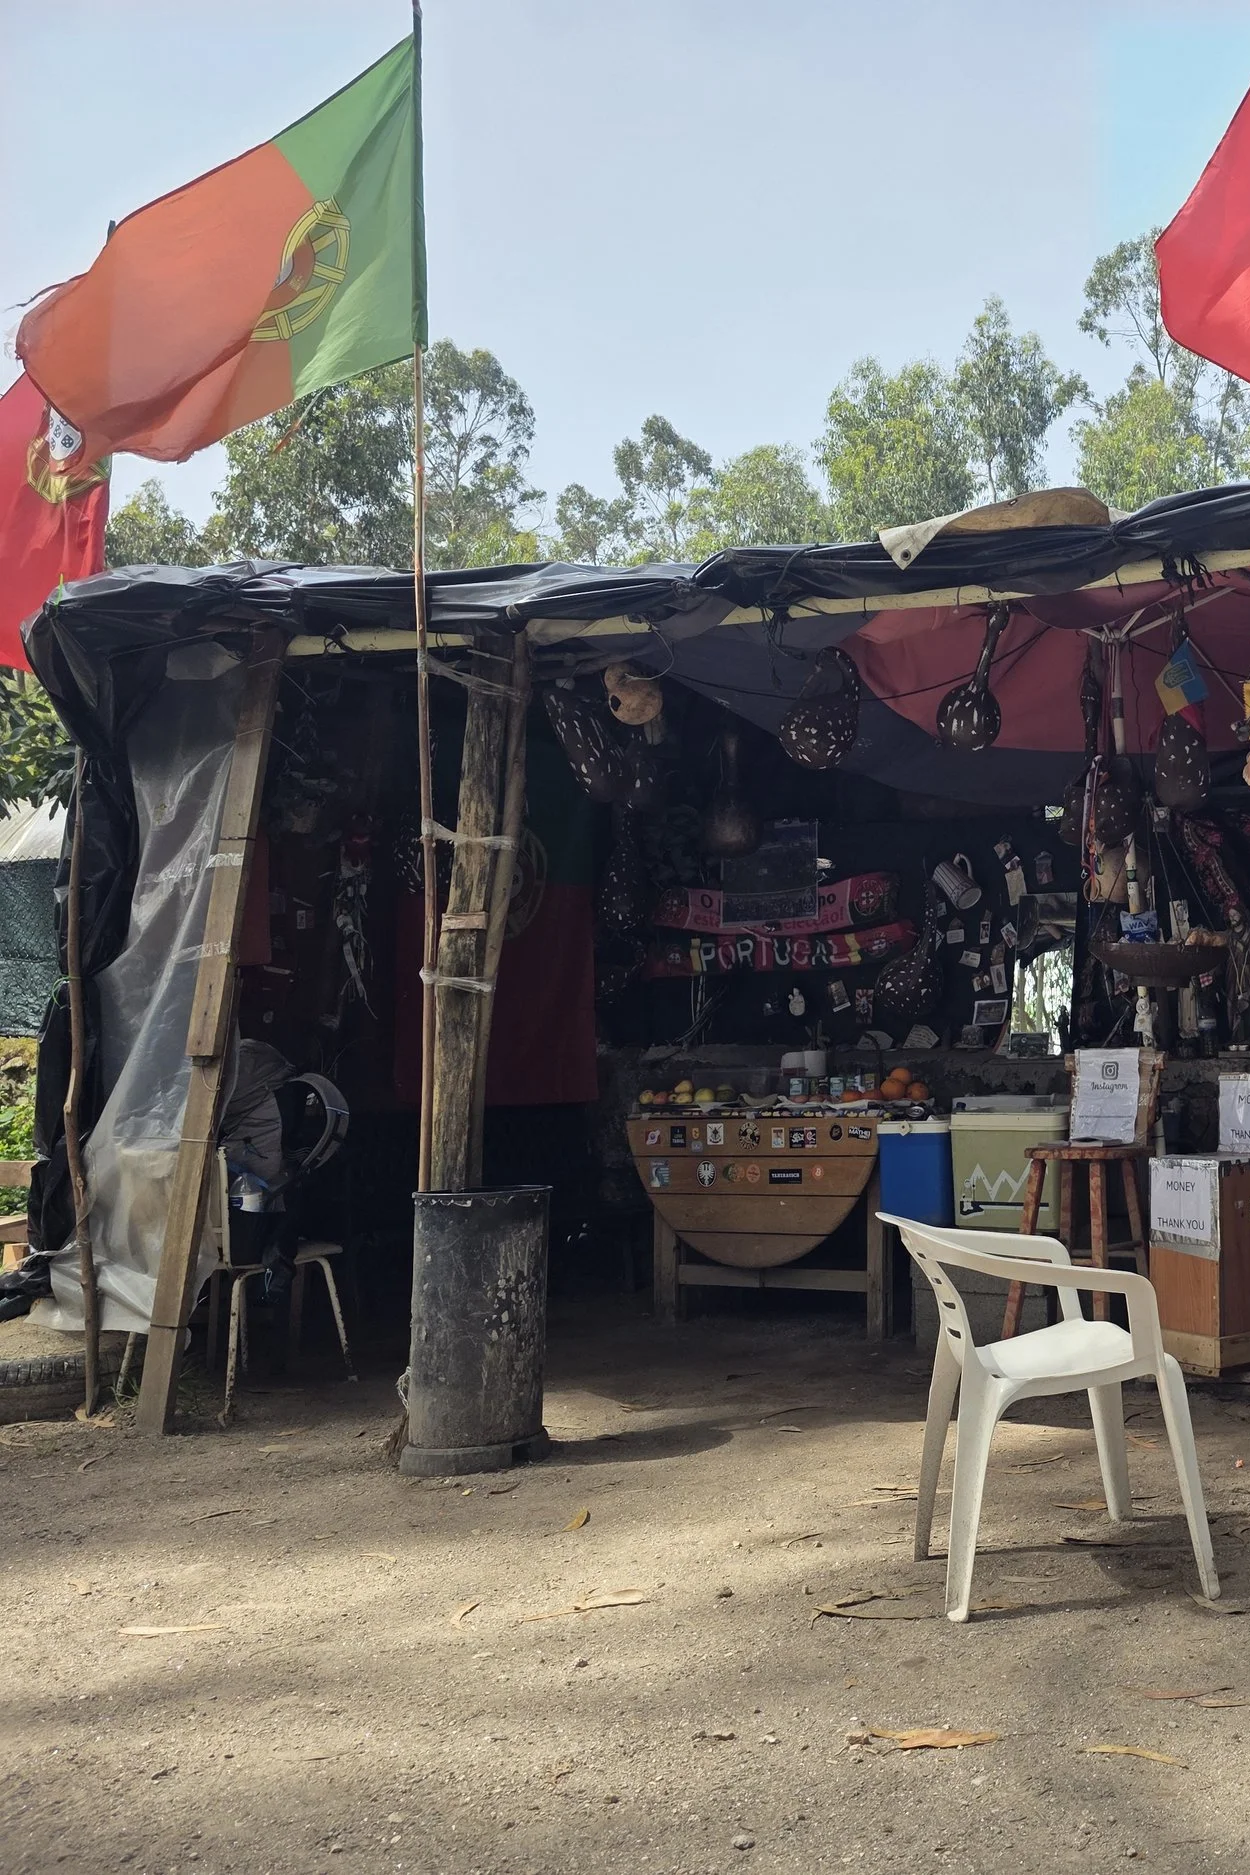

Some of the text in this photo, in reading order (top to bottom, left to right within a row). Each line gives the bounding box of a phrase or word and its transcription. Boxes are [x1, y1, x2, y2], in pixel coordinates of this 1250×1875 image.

[700, 937, 850, 972] PORTUGAL
[1090, 1081, 1129, 1094] Instagram
[1166, 1180, 1196, 1192] MONEY
[1157, 1216, 1205, 1231] THANK YOU
